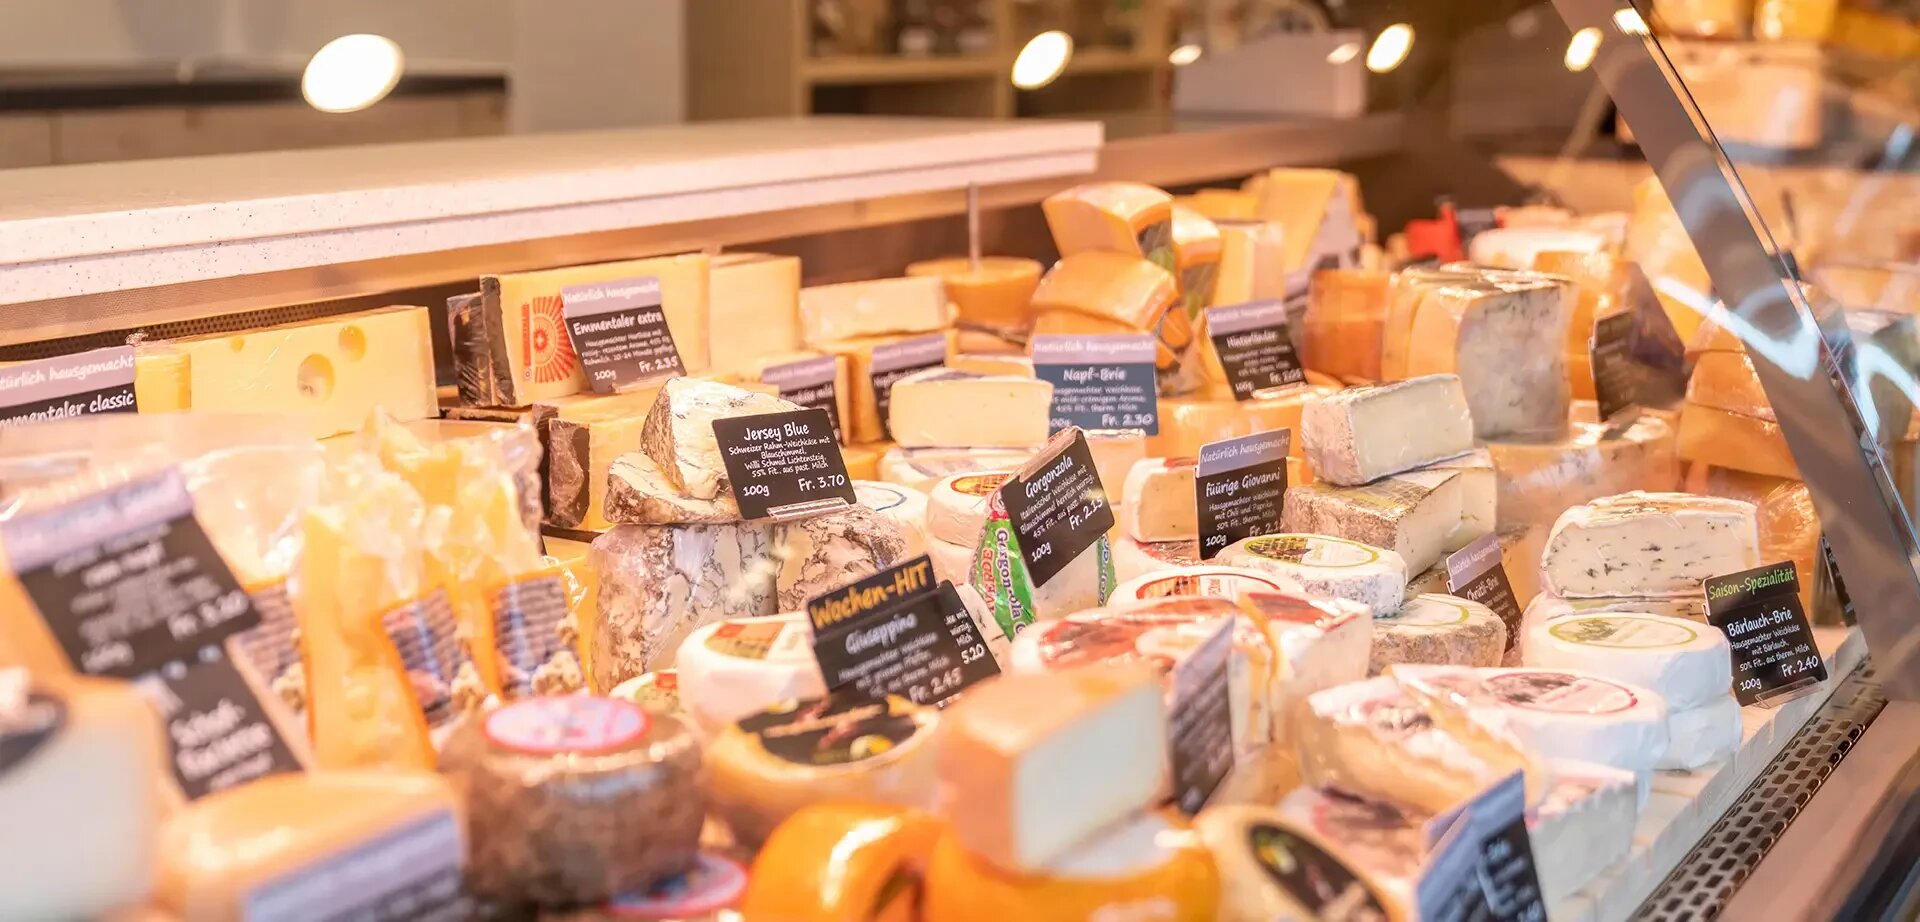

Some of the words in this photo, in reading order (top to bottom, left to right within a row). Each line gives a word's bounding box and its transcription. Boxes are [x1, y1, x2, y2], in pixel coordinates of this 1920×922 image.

[573, 314, 634, 335] Emmentaler
[637, 311, 662, 325] extra
[49, 355, 134, 381] hausgemacht
[593, 369, 617, 381] 100g
[639, 360, 655, 374] Fr.
[655, 356, 679, 369] 2.35
[1063, 367, 1127, 384] Napf-Brie
[89, 389, 135, 413] classic
[1102, 413, 1120, 427] Fr.
[1122, 413, 1154, 426] 2.30
[743, 426, 782, 441] Jersey
[784, 421, 810, 437] Blue
[728, 444, 762, 456] Schweizer
[819, 435, 831, 444] mit
[1201, 445, 1239, 464] Natürlich
[1240, 435, 1290, 456] hausgemacht
[744, 460, 761, 471] Willi
[761, 457, 786, 468] Schmid
[752, 468, 767, 478] 55%
[811, 459, 829, 469] Milch
[798, 478, 816, 492] Fr.
[817, 473, 846, 489] 3.70
[1025, 455, 1073, 498] Gorgonzola
[1241, 466, 1281, 490] Giovanni
[743, 484, 770, 497] 100g
[1069, 515, 1083, 531] Fr.
[1083, 497, 1104, 520] 2.15
[1205, 534, 1227, 547] 100g
[1249, 525, 1263, 537] Fr.
[1031, 541, 1052, 563] 100g
[1708, 567, 1795, 600] Saison-Spezialität
[810, 560, 930, 629] Wochen-HIT
[1727, 606, 1793, 637] Bärlauch-Brie
[1731, 632, 1772, 650] Hausgemachter
[1751, 645, 1763, 656] mit
[961, 643, 985, 664] 5.20
[1740, 661, 1753, 672] 50%
[1766, 655, 1776, 664] aus
[1795, 643, 1810, 655] Milch
[1781, 663, 1797, 677] Fr.
[1797, 655, 1819, 672] 2.40
[1740, 678, 1762, 691] 100g
